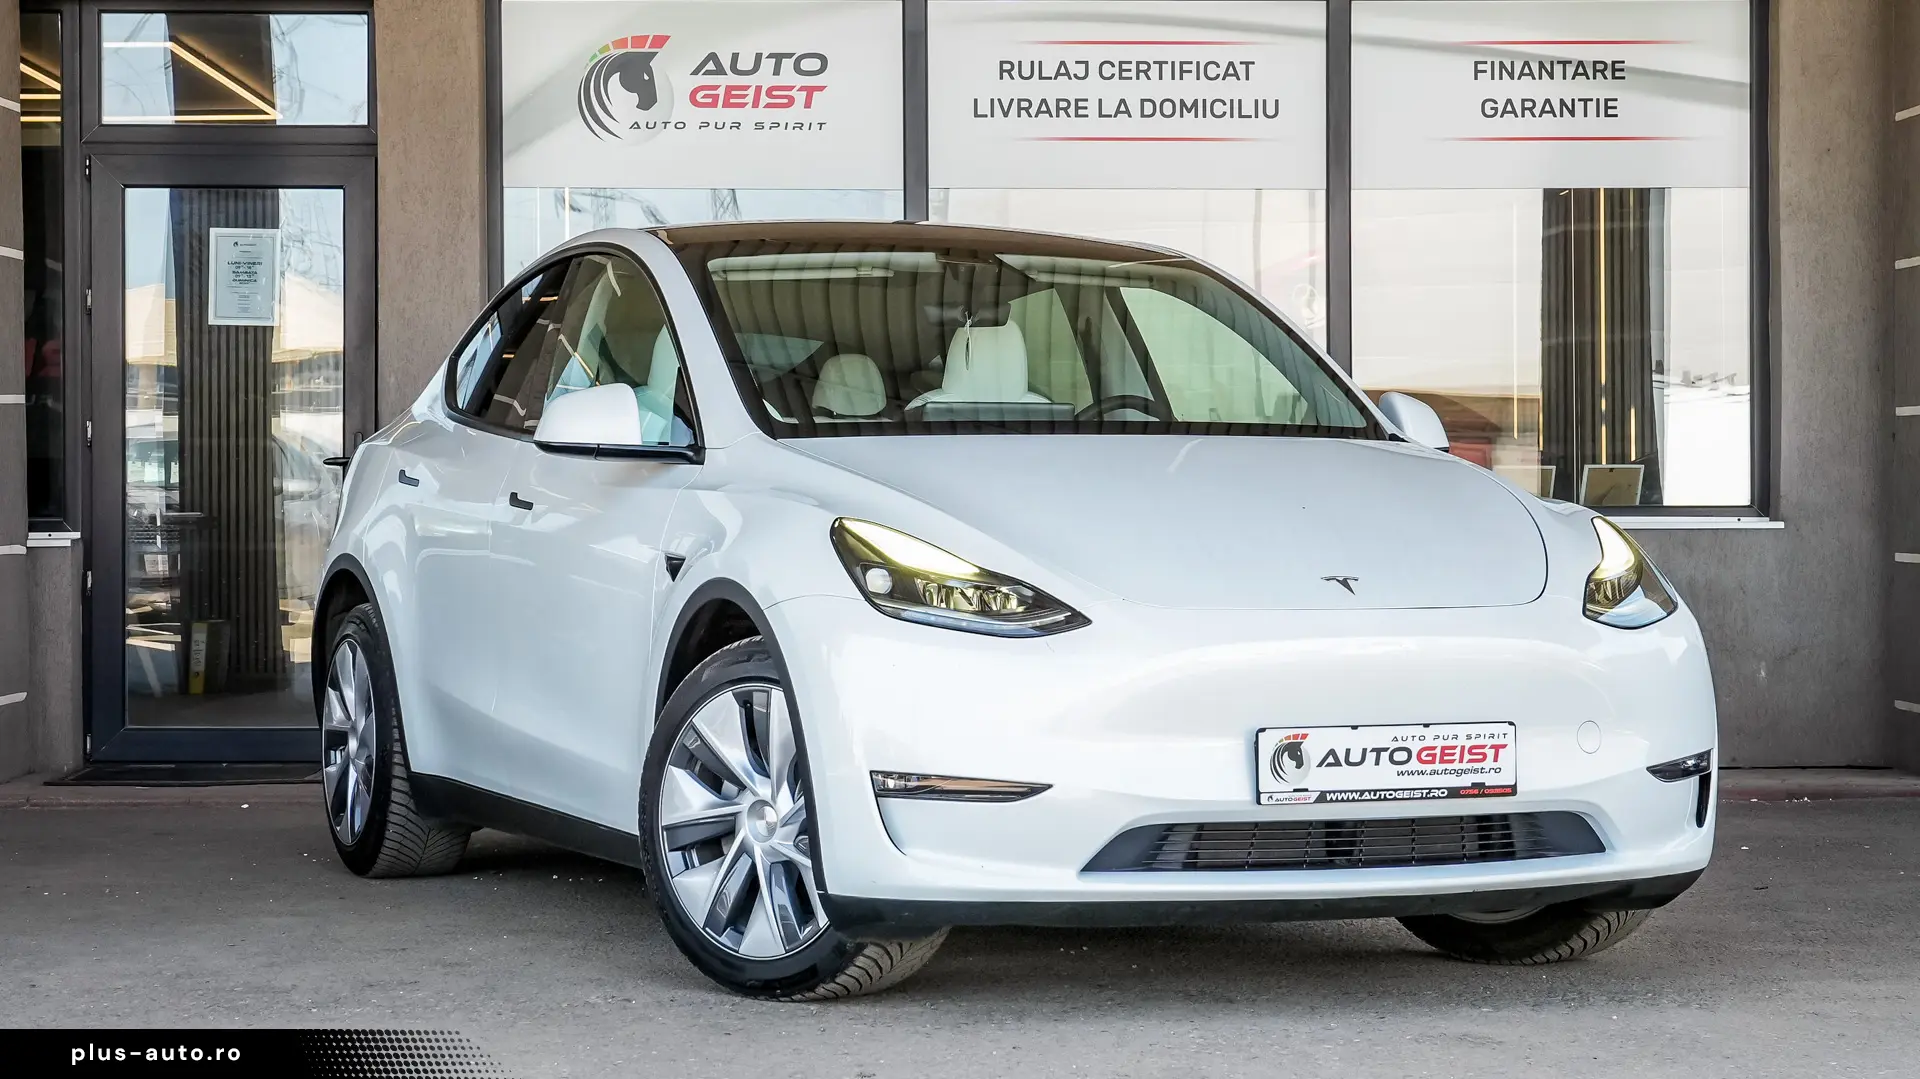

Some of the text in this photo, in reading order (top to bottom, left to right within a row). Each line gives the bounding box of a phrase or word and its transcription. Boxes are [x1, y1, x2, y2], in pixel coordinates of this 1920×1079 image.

[690, 52, 829, 76] AUTO
[998, 60, 1255, 81] RULAJ CERTIFICAT
[1473, 60, 1626, 80] FINANTARE
[689, 85, 828, 109] GEIST
[973, 98, 1280, 119] LIVRARE LA DOMICILIU
[1480, 98, 1619, 118] GARANTIE
[629, 121, 828, 131] AUTO PUR SPIRIT
[1465, 732, 1509, 740] SPIRIT
[1396, 766, 1502, 777] www.autogeist.ro
[1326, 788, 1448, 801] WWW.AUTOGEIST.RO
